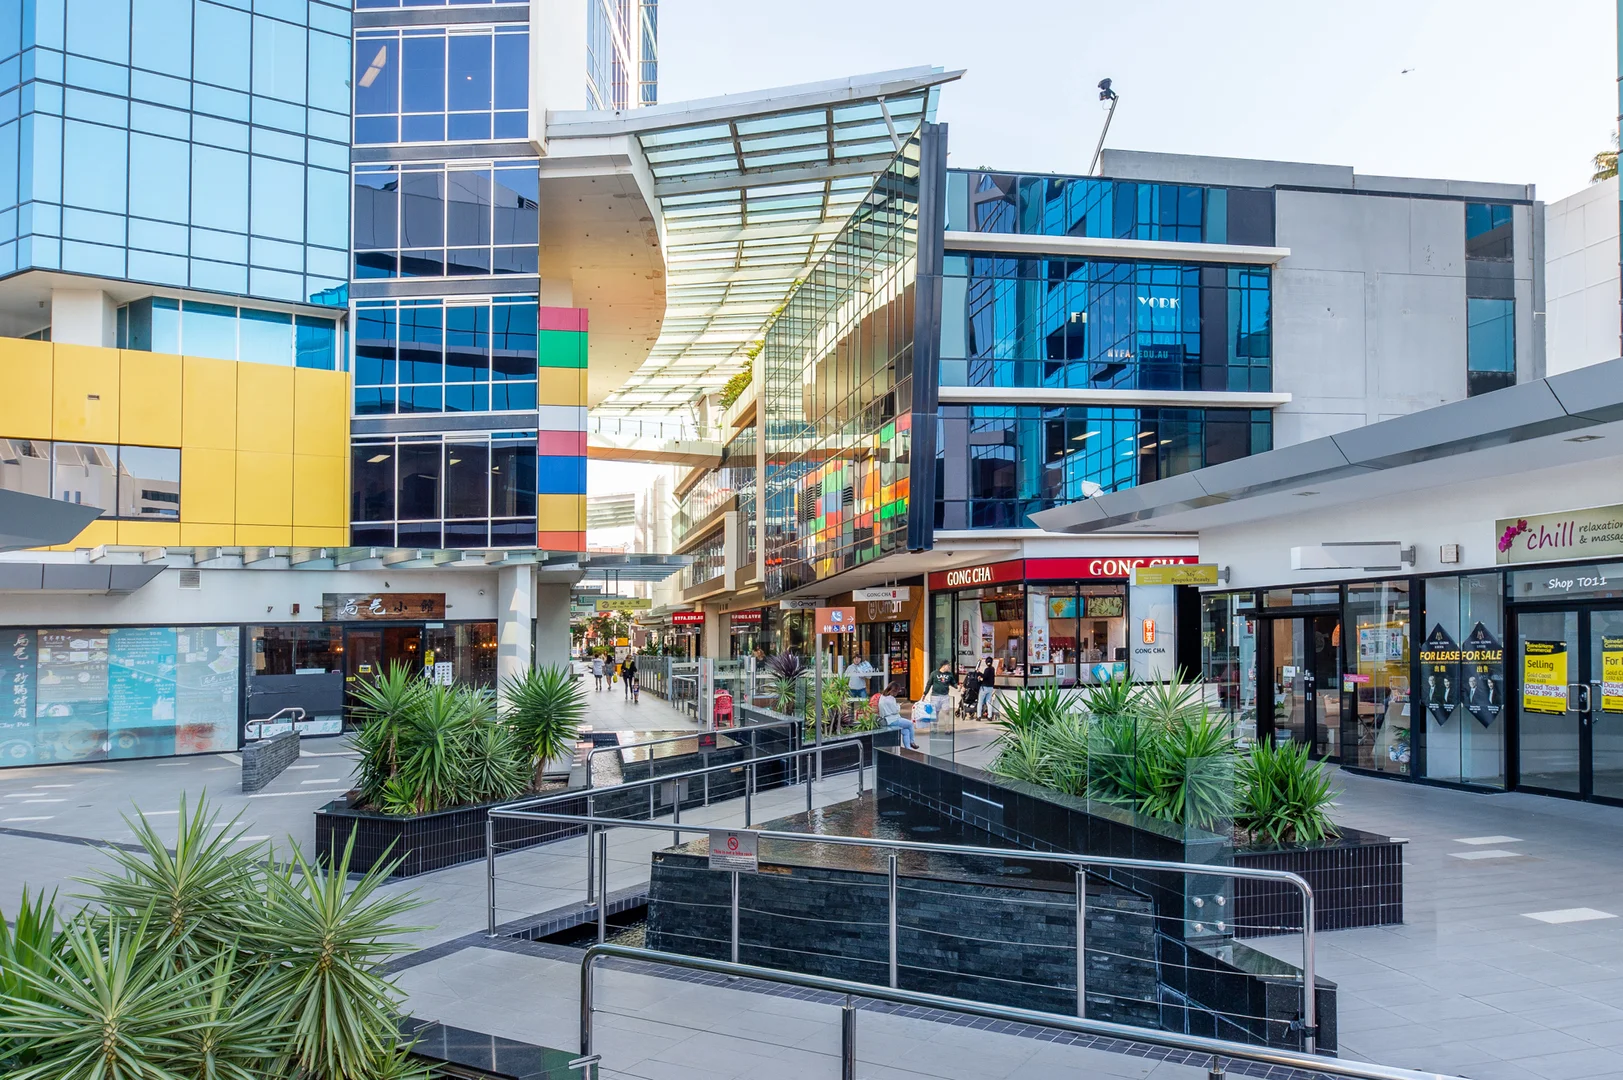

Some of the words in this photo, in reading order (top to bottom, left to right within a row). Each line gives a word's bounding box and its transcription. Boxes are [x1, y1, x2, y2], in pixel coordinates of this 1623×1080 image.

[1137, 296, 1180, 308] YORK
[1107, 349, 1168, 359] NYFA.EDU.AU
[1527, 520, 1574, 550] chill
[1579, 534, 1588, 544] &
[947, 569, 972, 586] GONG
[972, 566, 992, 582] CHA
[1549, 578, 1574, 591] Shop
[1420, 651, 1436, 660] FOR
[1436, 651, 1460, 660] LEASE
[1462, 651, 1480, 660] FOR
[1481, 650, 1503, 660] SALE
[1528, 660, 1554, 671] Selling
[1606, 657, 1619, 665] For
